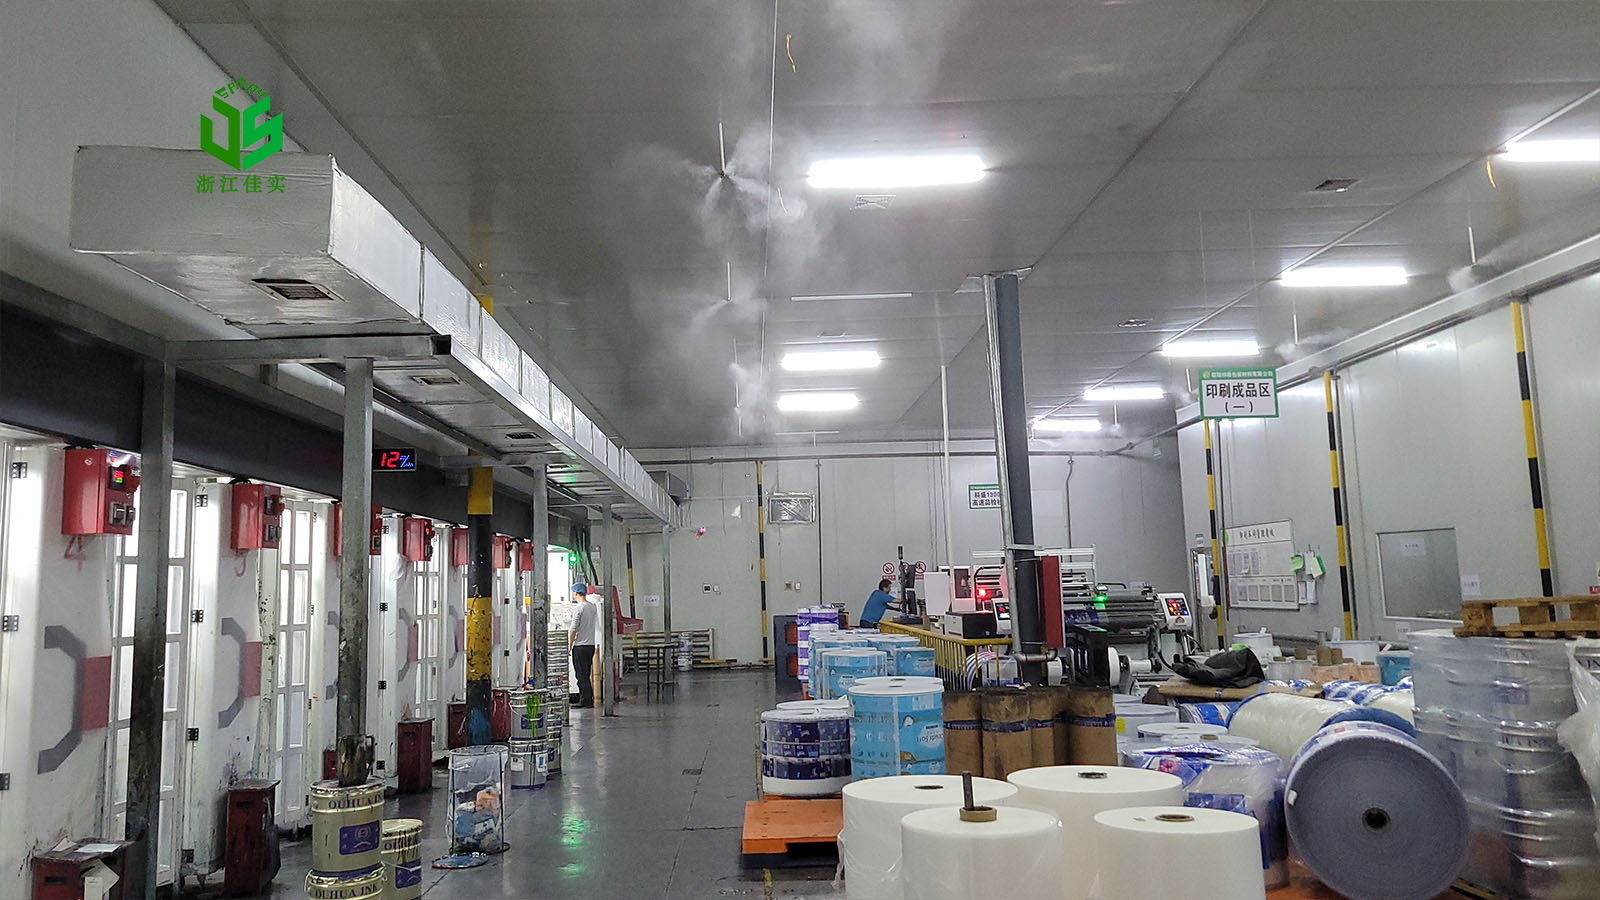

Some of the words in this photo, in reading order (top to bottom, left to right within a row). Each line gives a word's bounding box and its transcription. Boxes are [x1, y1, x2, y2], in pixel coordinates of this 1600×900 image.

[1206, 383, 1271, 399] 印刷成品区
